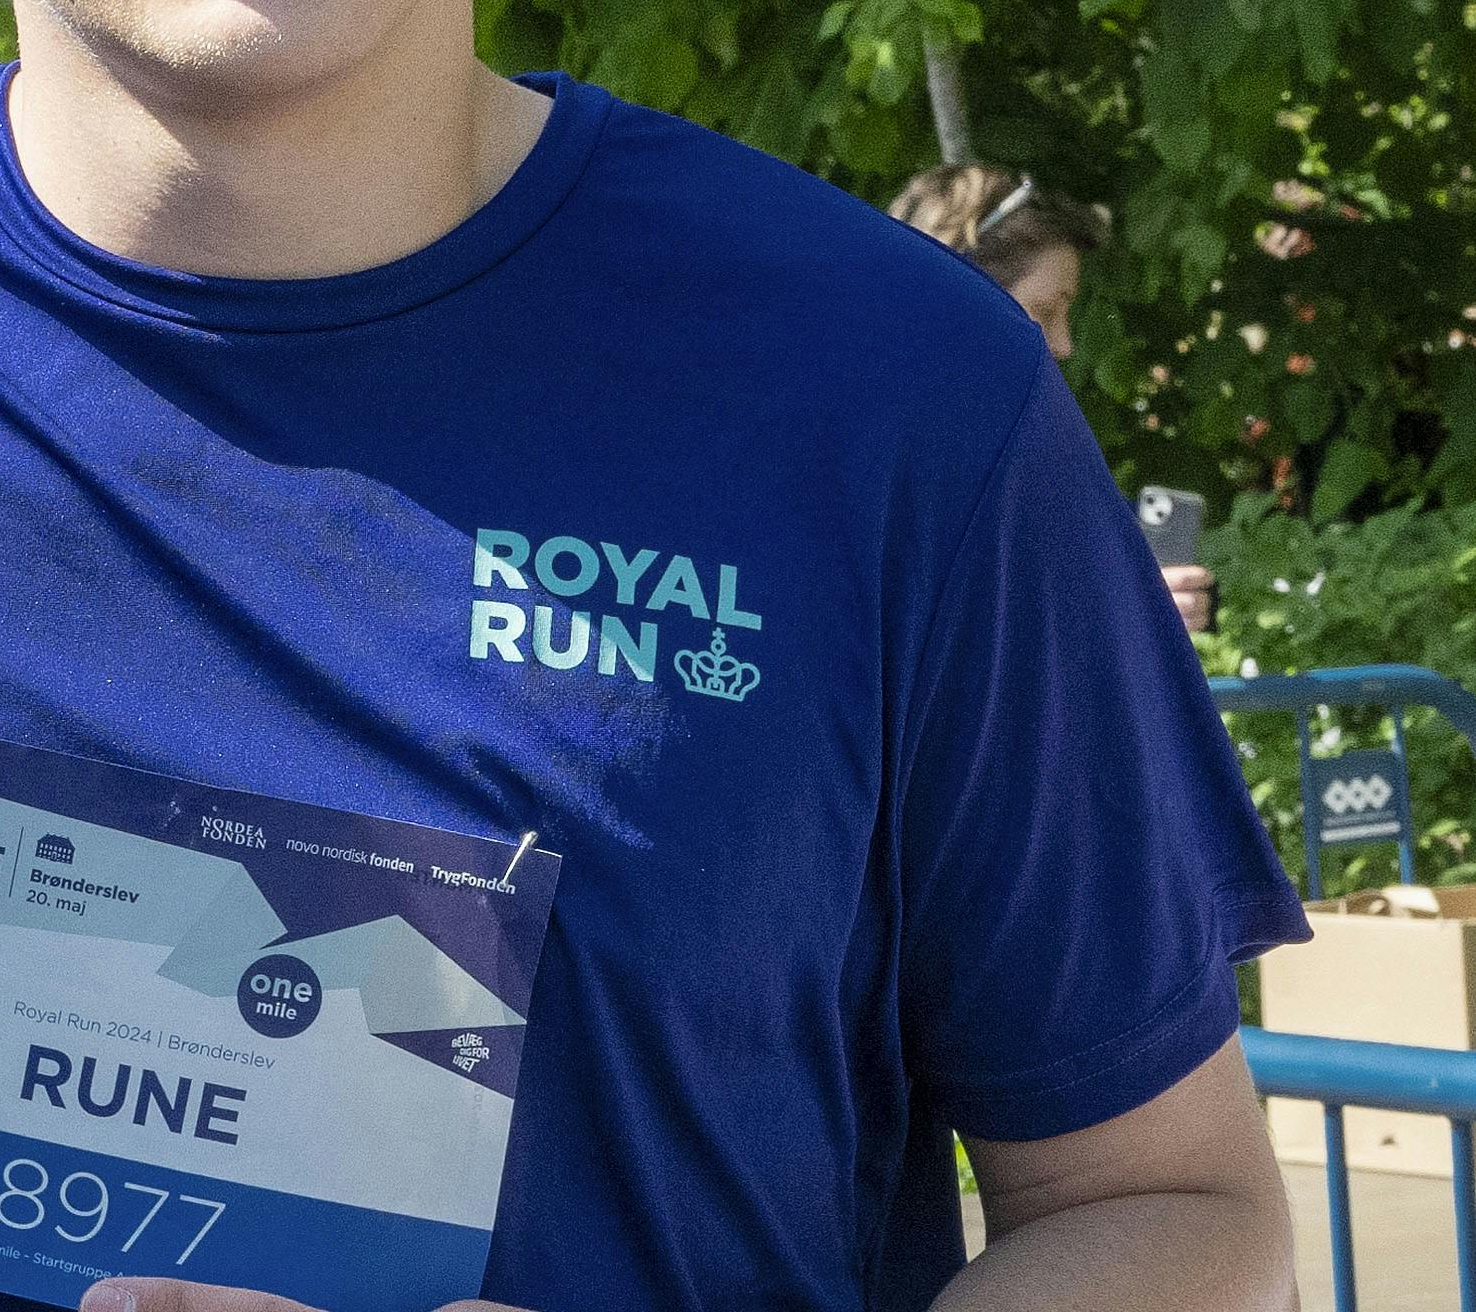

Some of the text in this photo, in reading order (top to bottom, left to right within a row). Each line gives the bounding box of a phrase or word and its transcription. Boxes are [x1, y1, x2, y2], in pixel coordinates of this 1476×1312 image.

[473, 527, 762, 630] ROYAL
[470, 599, 657, 682] RUN
[201, 815, 263, 838] NORDEA
[202, 826, 267, 849] FONDEN
[286, 838, 414, 873] novo nordisk fonden
[30, 868, 140, 904] Brønderslev
[431, 865, 516, 894] TrygFonden
[26, 889, 87, 916] 20. maj
[250, 973, 313, 1003] one
[256, 1001, 297, 1020] mile
[13, 1001, 62, 1024] Royal
[67, 1013, 101, 1034] Run
[106, 1021, 152, 1044] 2024
[169, 1034, 276, 1069] Brønderslev
[20, 1044, 248, 1145] RUNE
[33, 1252, 112, 1279] Startgruppe
